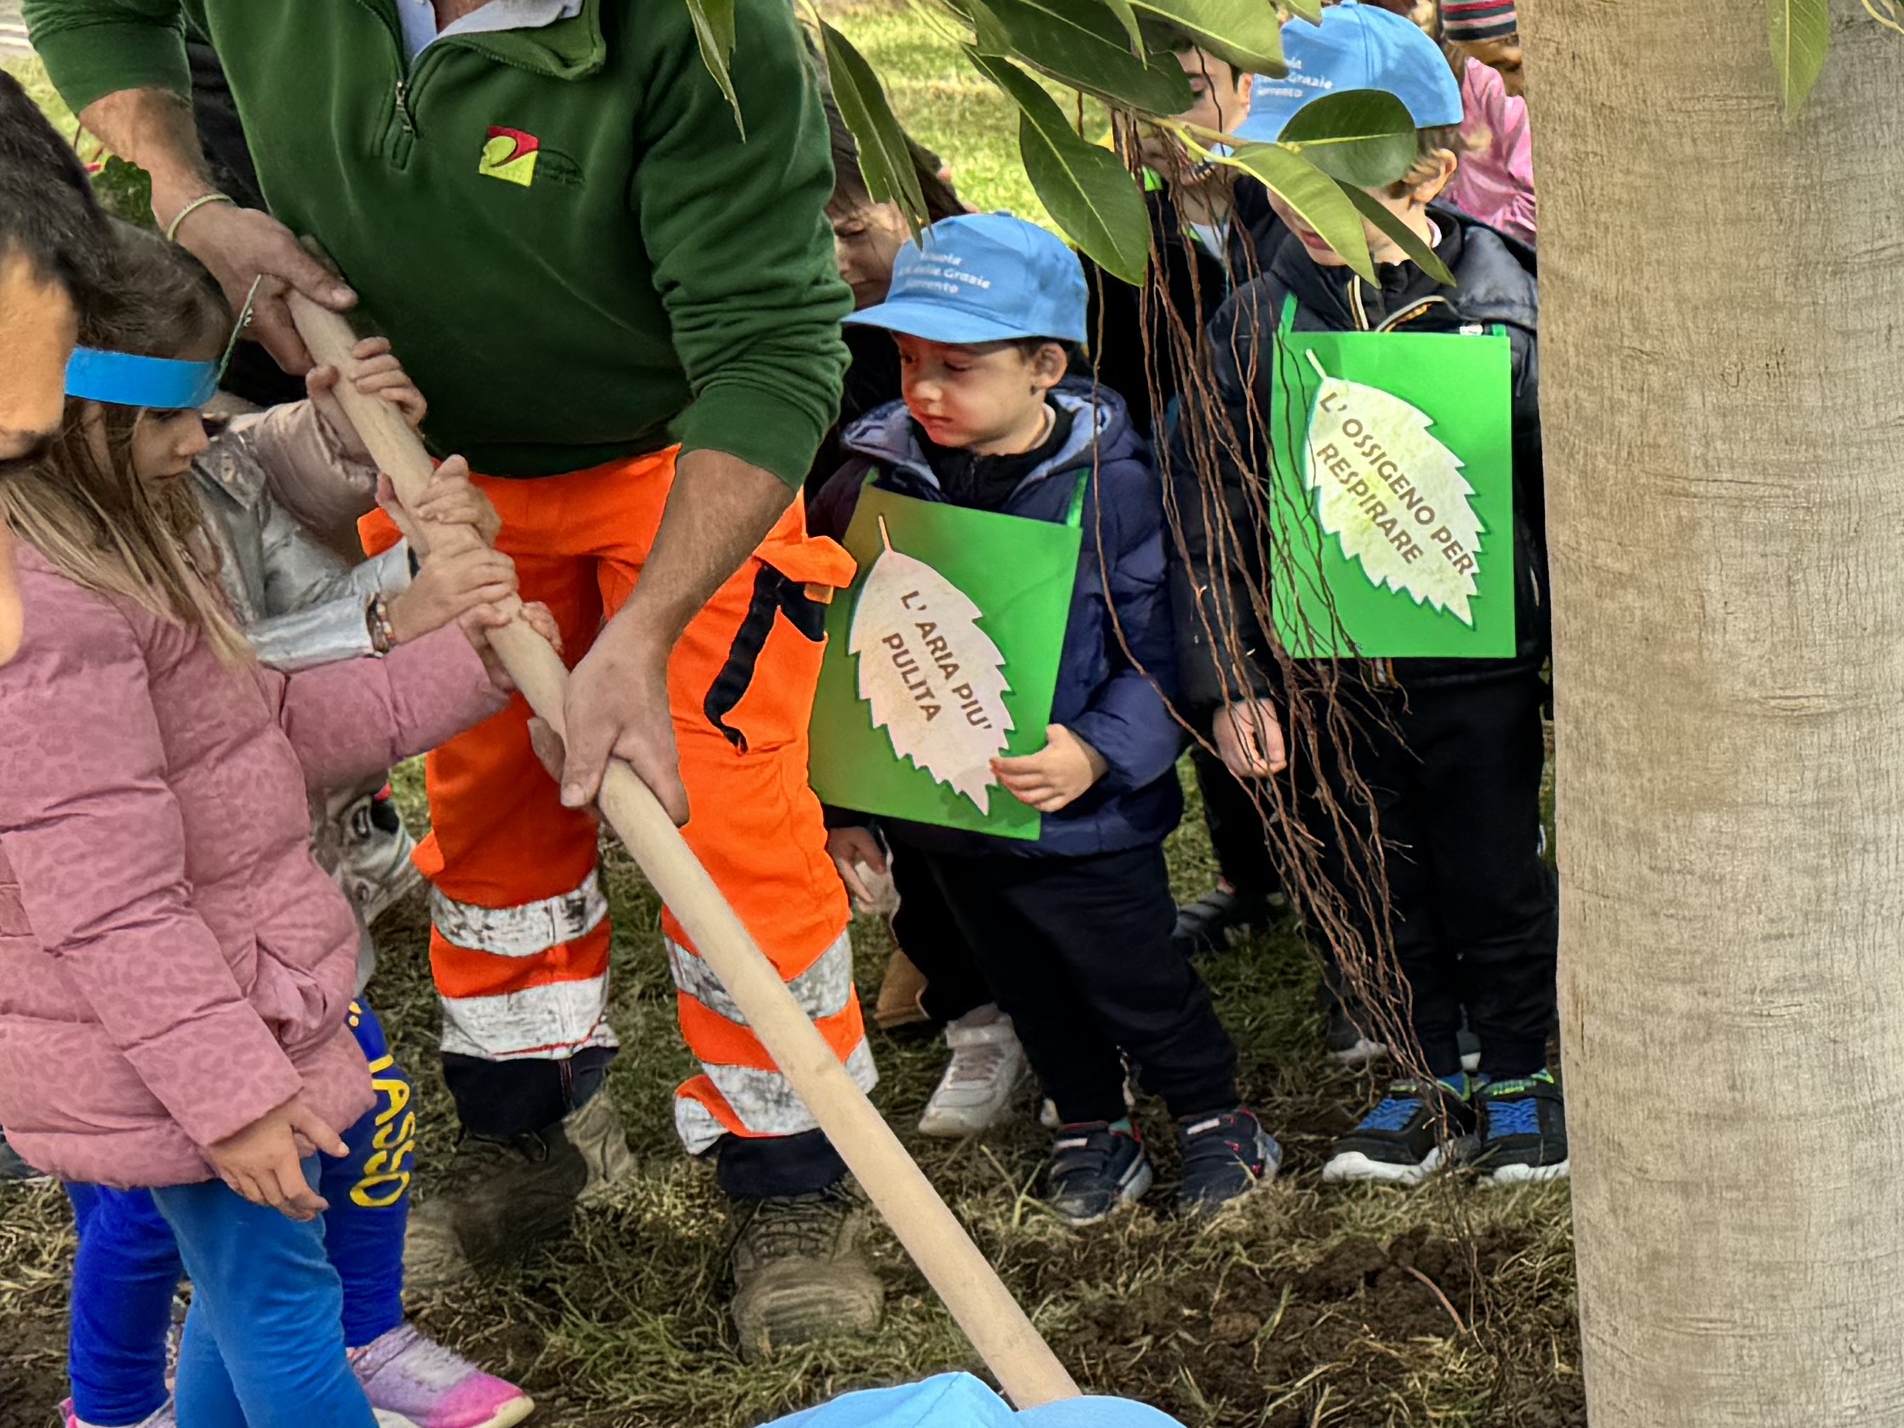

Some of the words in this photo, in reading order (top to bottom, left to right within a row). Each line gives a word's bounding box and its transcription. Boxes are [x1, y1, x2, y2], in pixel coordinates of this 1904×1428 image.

[1316, 442, 1424, 565] RESPIRARE
[1319, 391, 1348, 413] L'
[1342, 418, 1436, 526] OSSIGENO
[1430, 525, 1474, 576] PER
[881, 632, 942, 722] PULITA
[900, 590, 927, 611] L'
[915, 622, 960, 681] ARIA
[951, 682, 993, 730] PIU'
